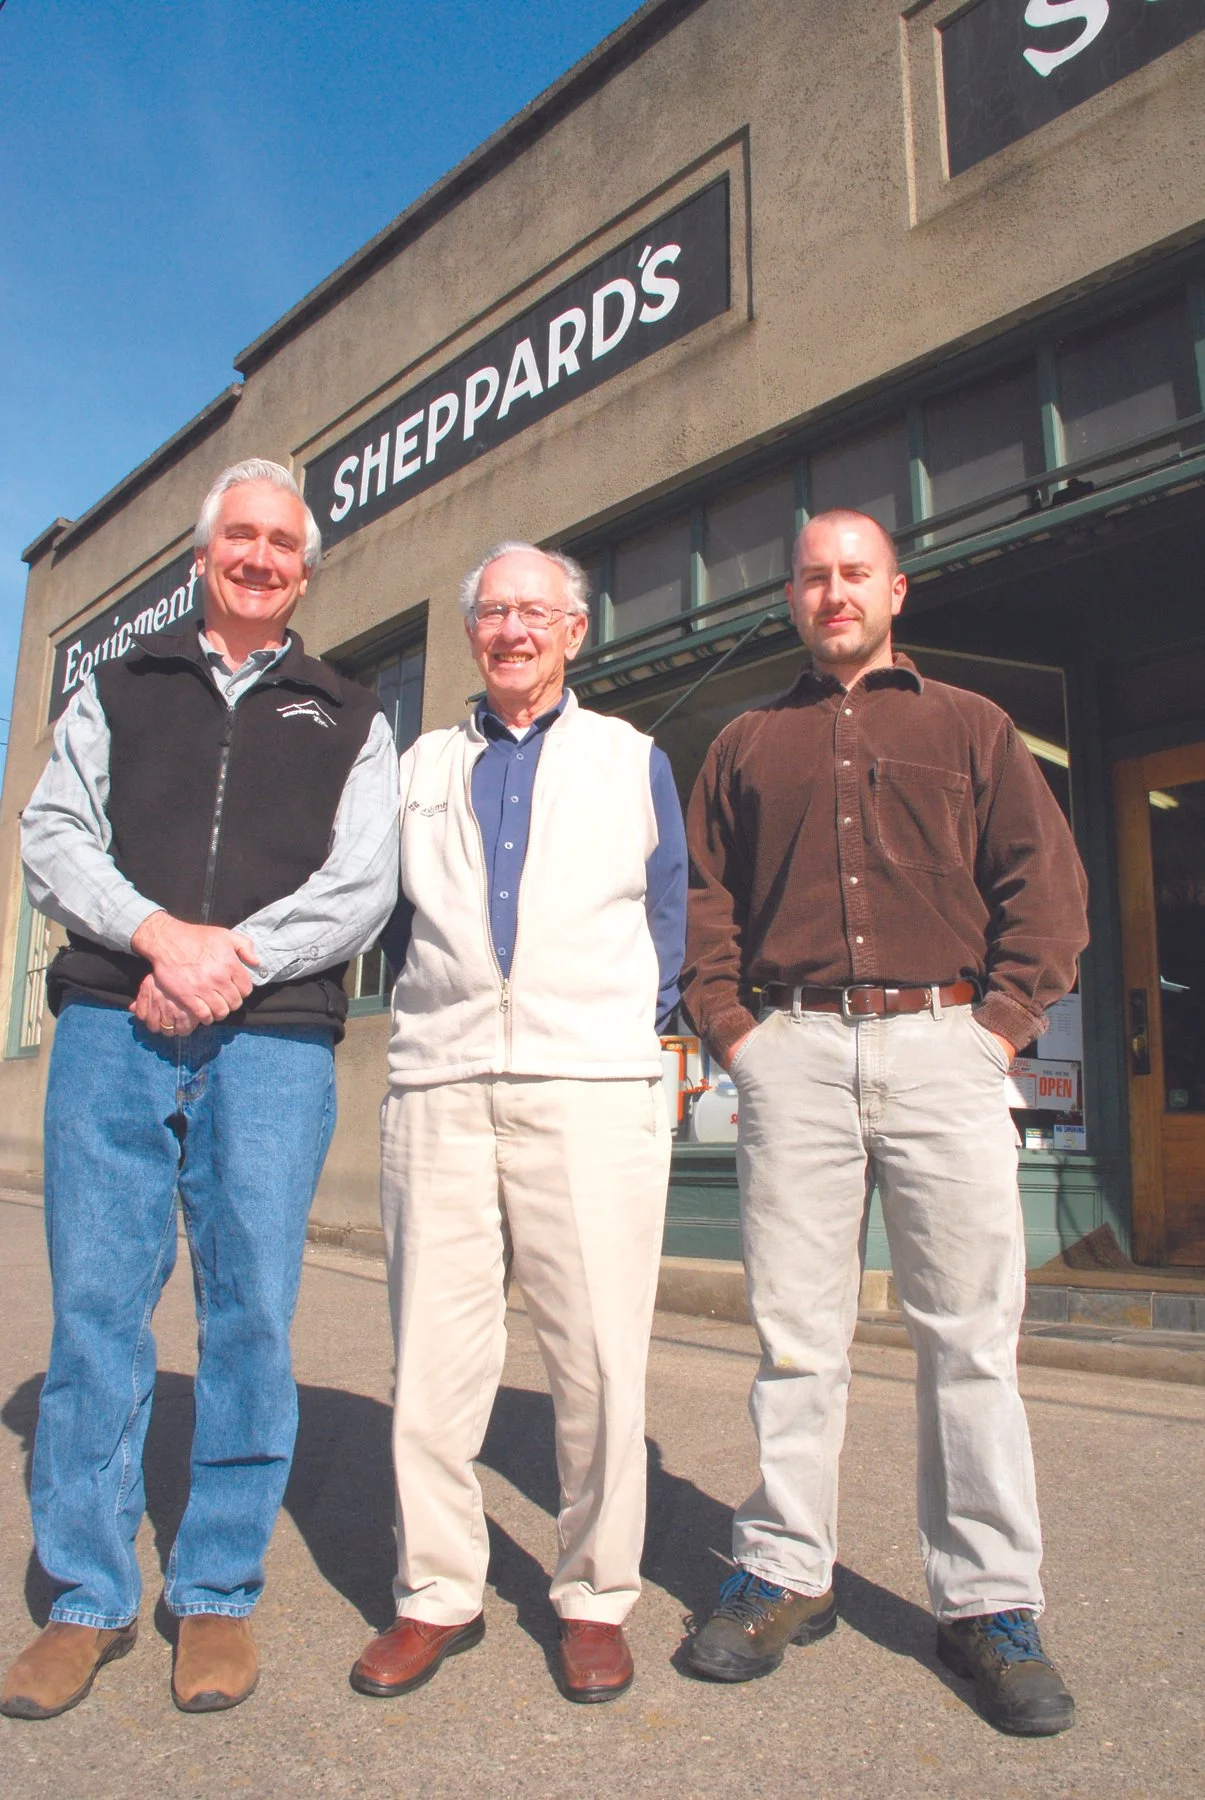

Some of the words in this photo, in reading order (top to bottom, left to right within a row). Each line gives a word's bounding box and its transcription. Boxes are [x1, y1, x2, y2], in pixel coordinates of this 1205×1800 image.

[330, 243, 682, 522] SHEPPARD'S
[1039, 1077, 1072, 1098] OPEN
[1063, 1126, 1085, 1134] SMOKING
